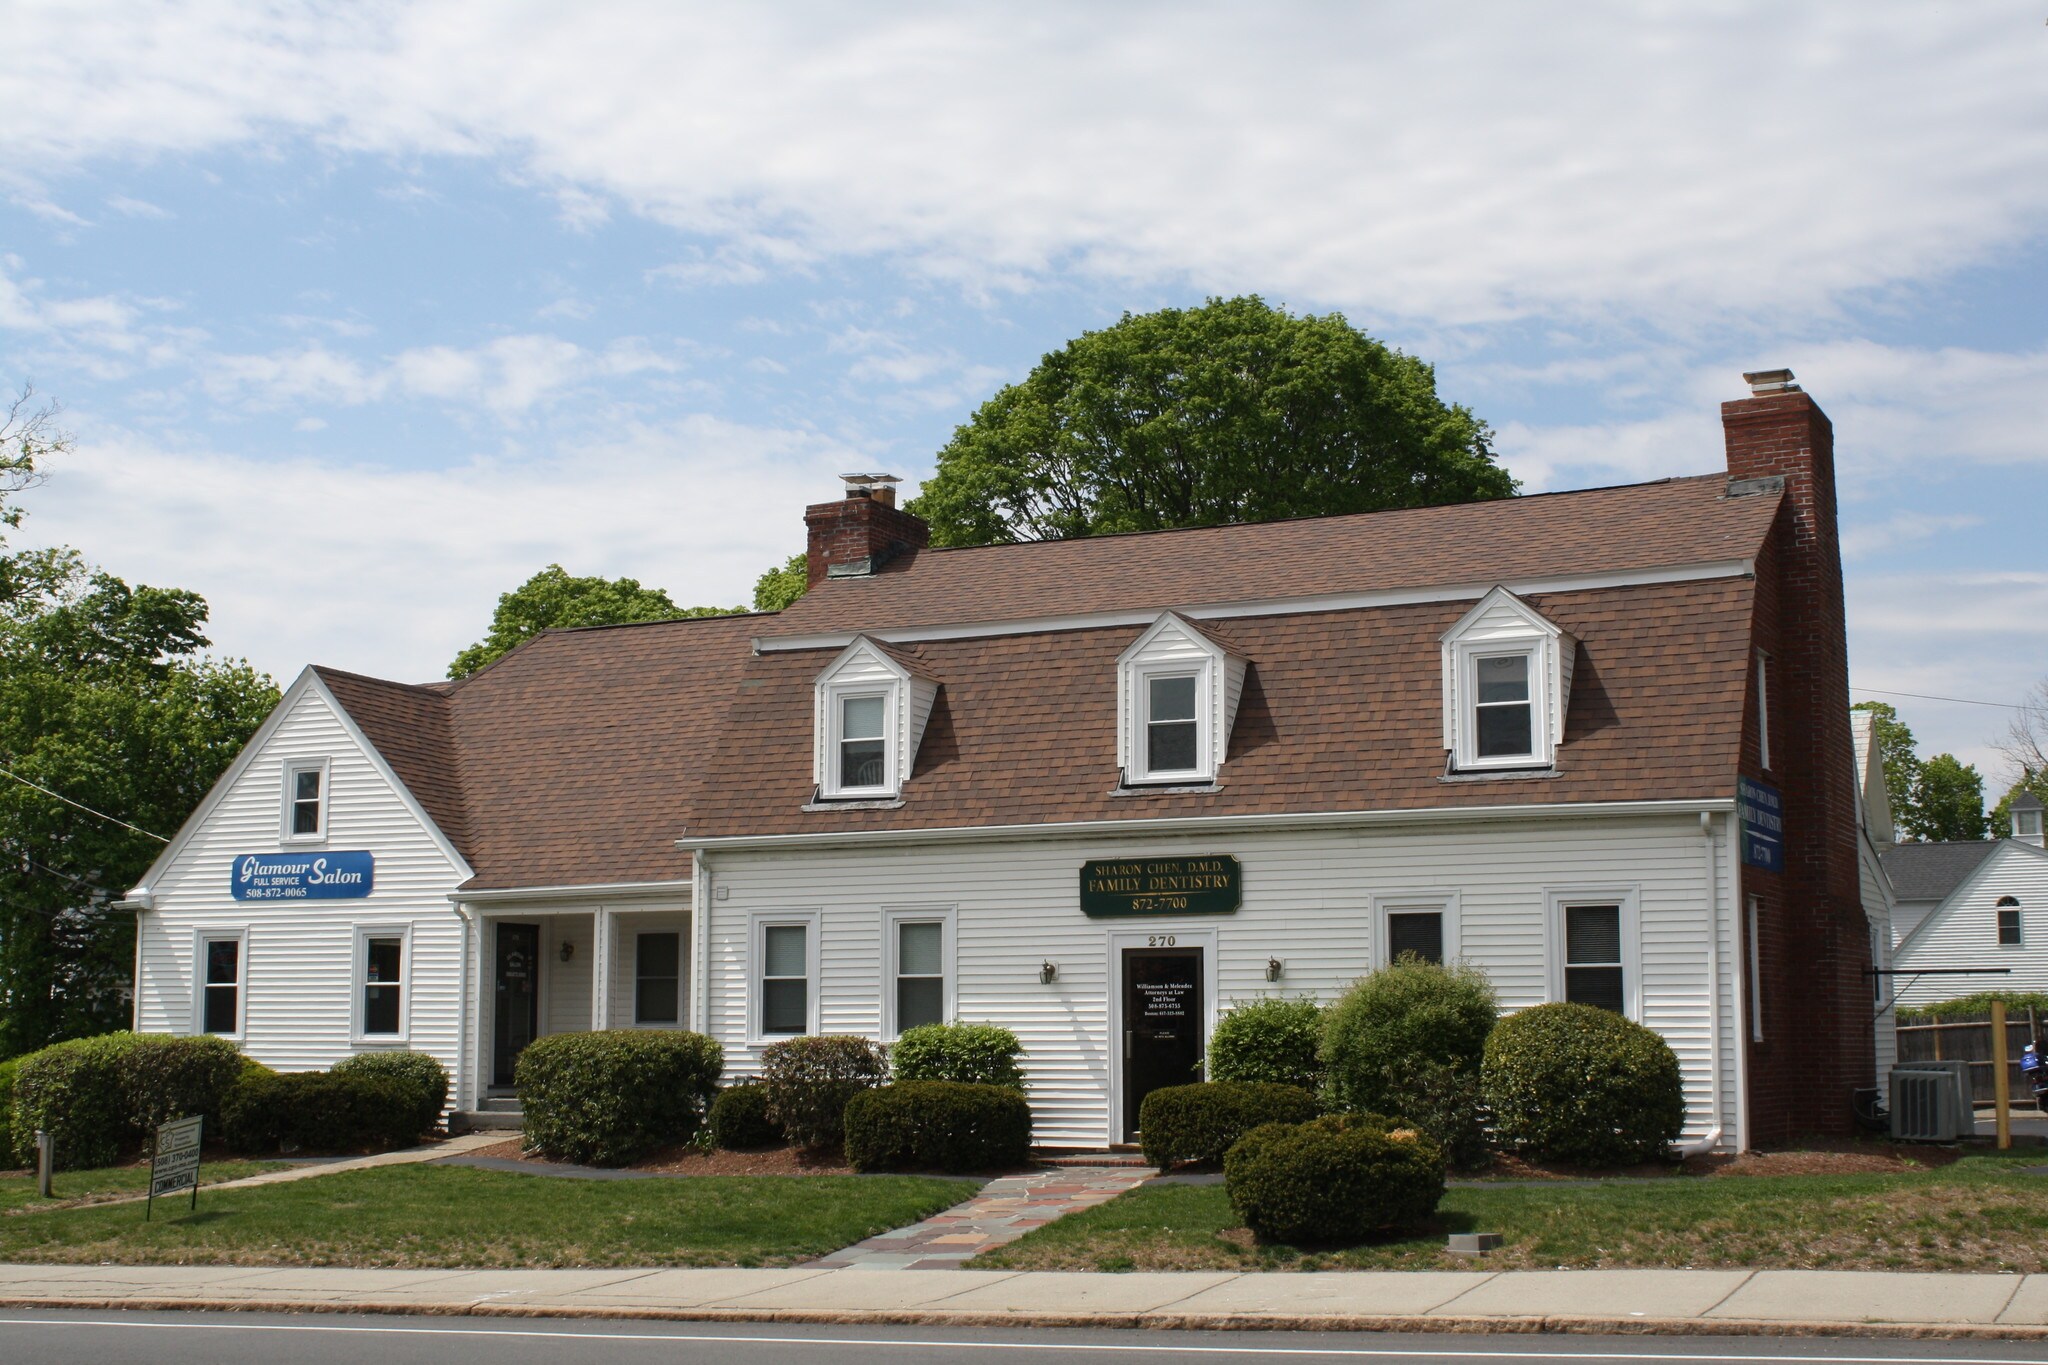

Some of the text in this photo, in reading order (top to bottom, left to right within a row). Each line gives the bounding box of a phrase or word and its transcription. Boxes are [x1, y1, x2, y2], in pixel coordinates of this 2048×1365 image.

[240, 856, 362, 884] Glamour Salon
[1095, 860, 1224, 876] SHARON CHEN, D.M.D.
[253, 876, 300, 886] FULL SERVICE
[1089, 874, 1230, 892] FAMILY DENTISTRY
[246, 887, 307, 898] 508-872-0065
[1132, 897, 1187, 910] 872-7700
[1149, 936, 1176, 946] 270
[155, 1171, 194, 1193] COMMERCIAL
